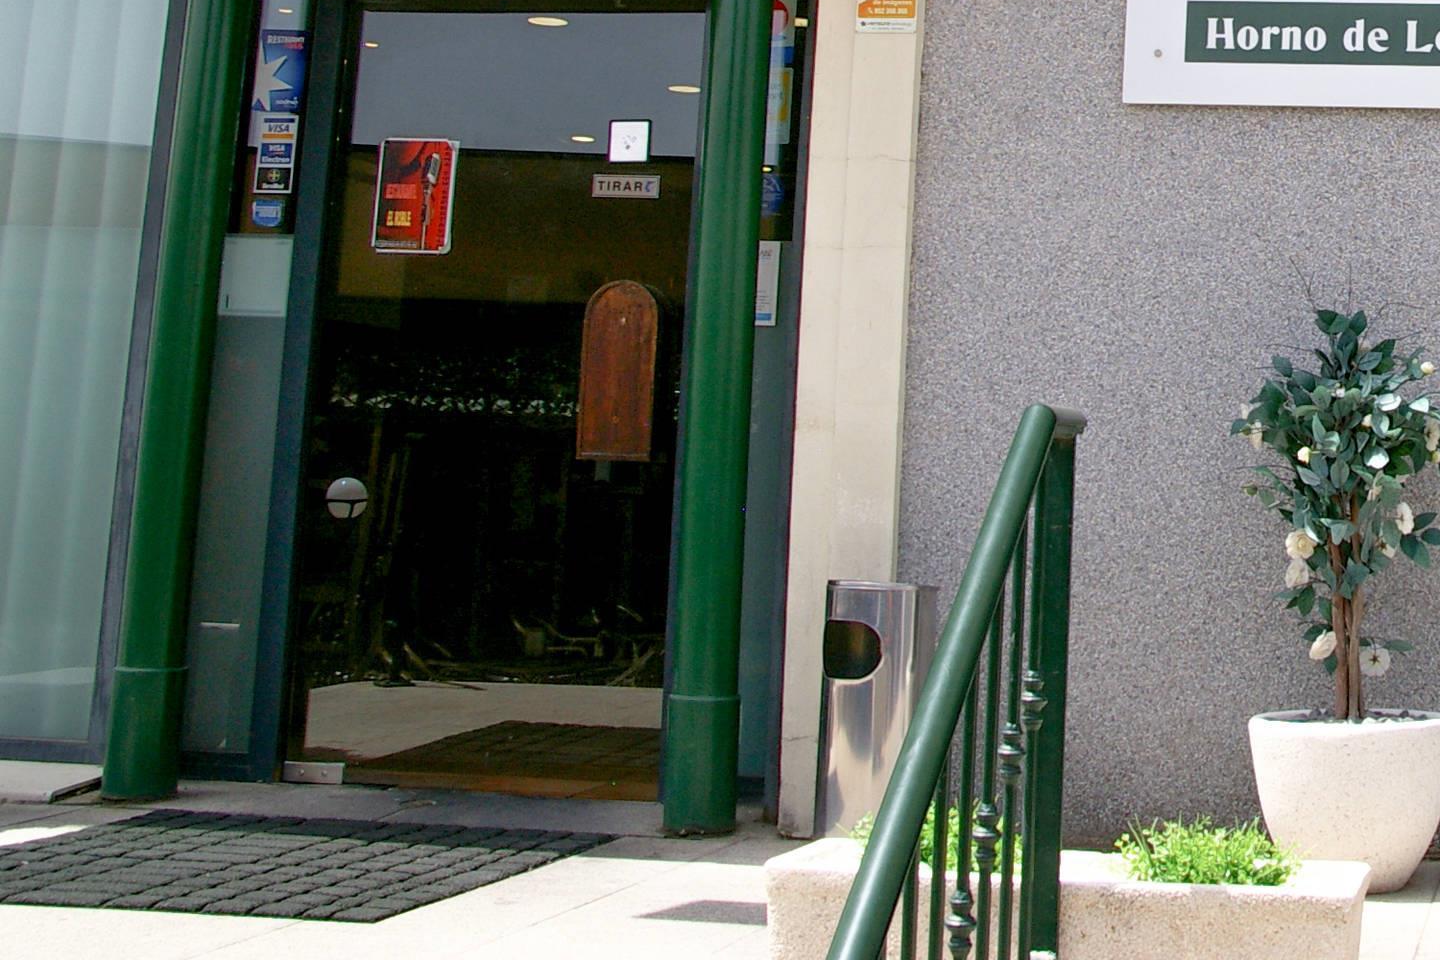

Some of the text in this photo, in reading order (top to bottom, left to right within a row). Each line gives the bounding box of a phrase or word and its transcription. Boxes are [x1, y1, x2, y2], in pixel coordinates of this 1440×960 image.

[1205, 17, 1328, 51] Horno
[1343, 18, 1390, 53] de
[267, 123, 290, 133] VISA
[598, 181, 643, 192] TIRAR
